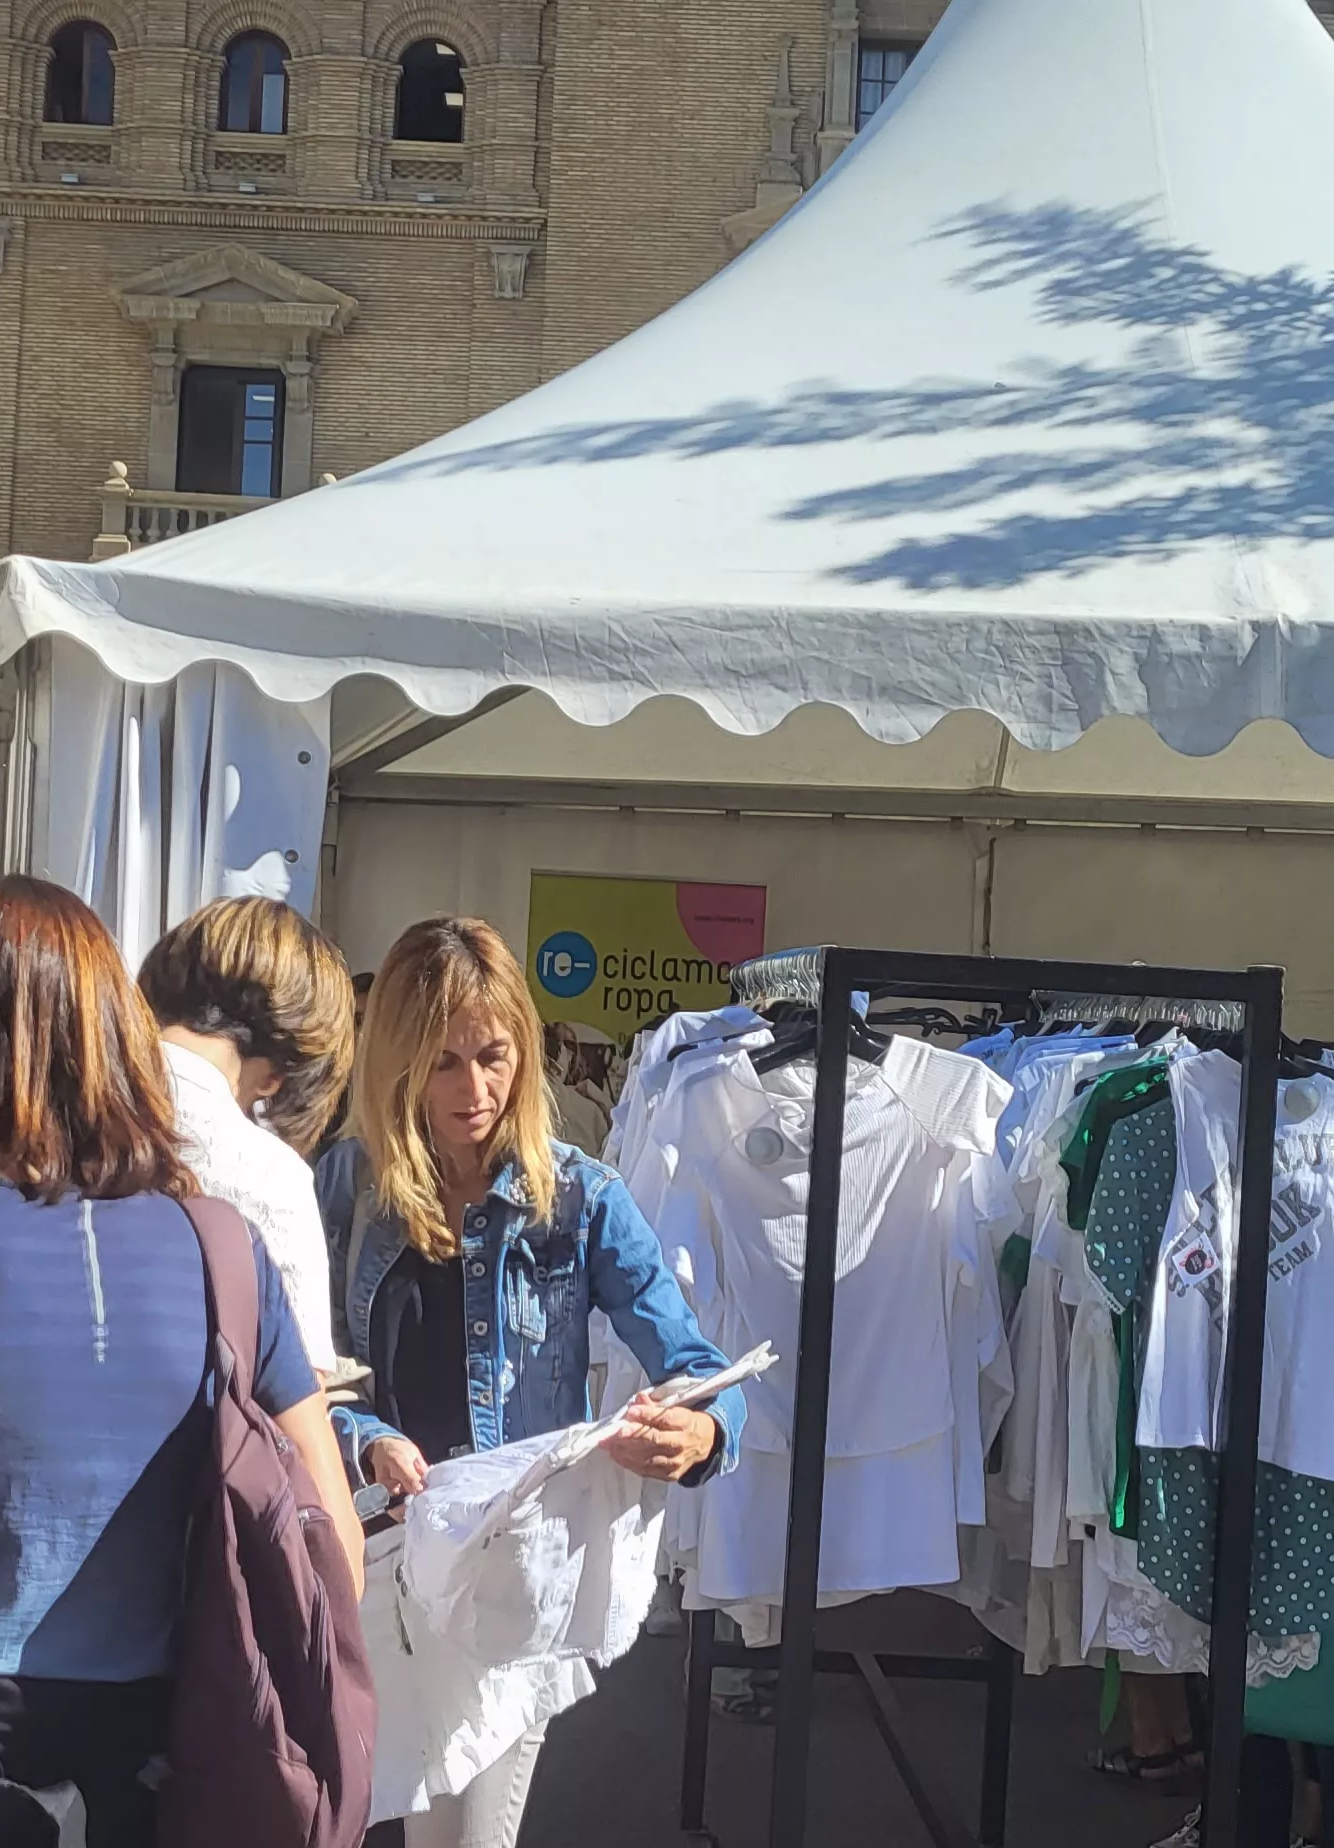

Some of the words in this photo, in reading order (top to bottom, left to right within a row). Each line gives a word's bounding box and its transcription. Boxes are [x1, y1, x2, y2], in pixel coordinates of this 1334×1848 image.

[603, 948, 732, 985] ciclamo
[602, 985, 675, 1020] ropa
[1268, 1241, 1315, 1283] TEAM
